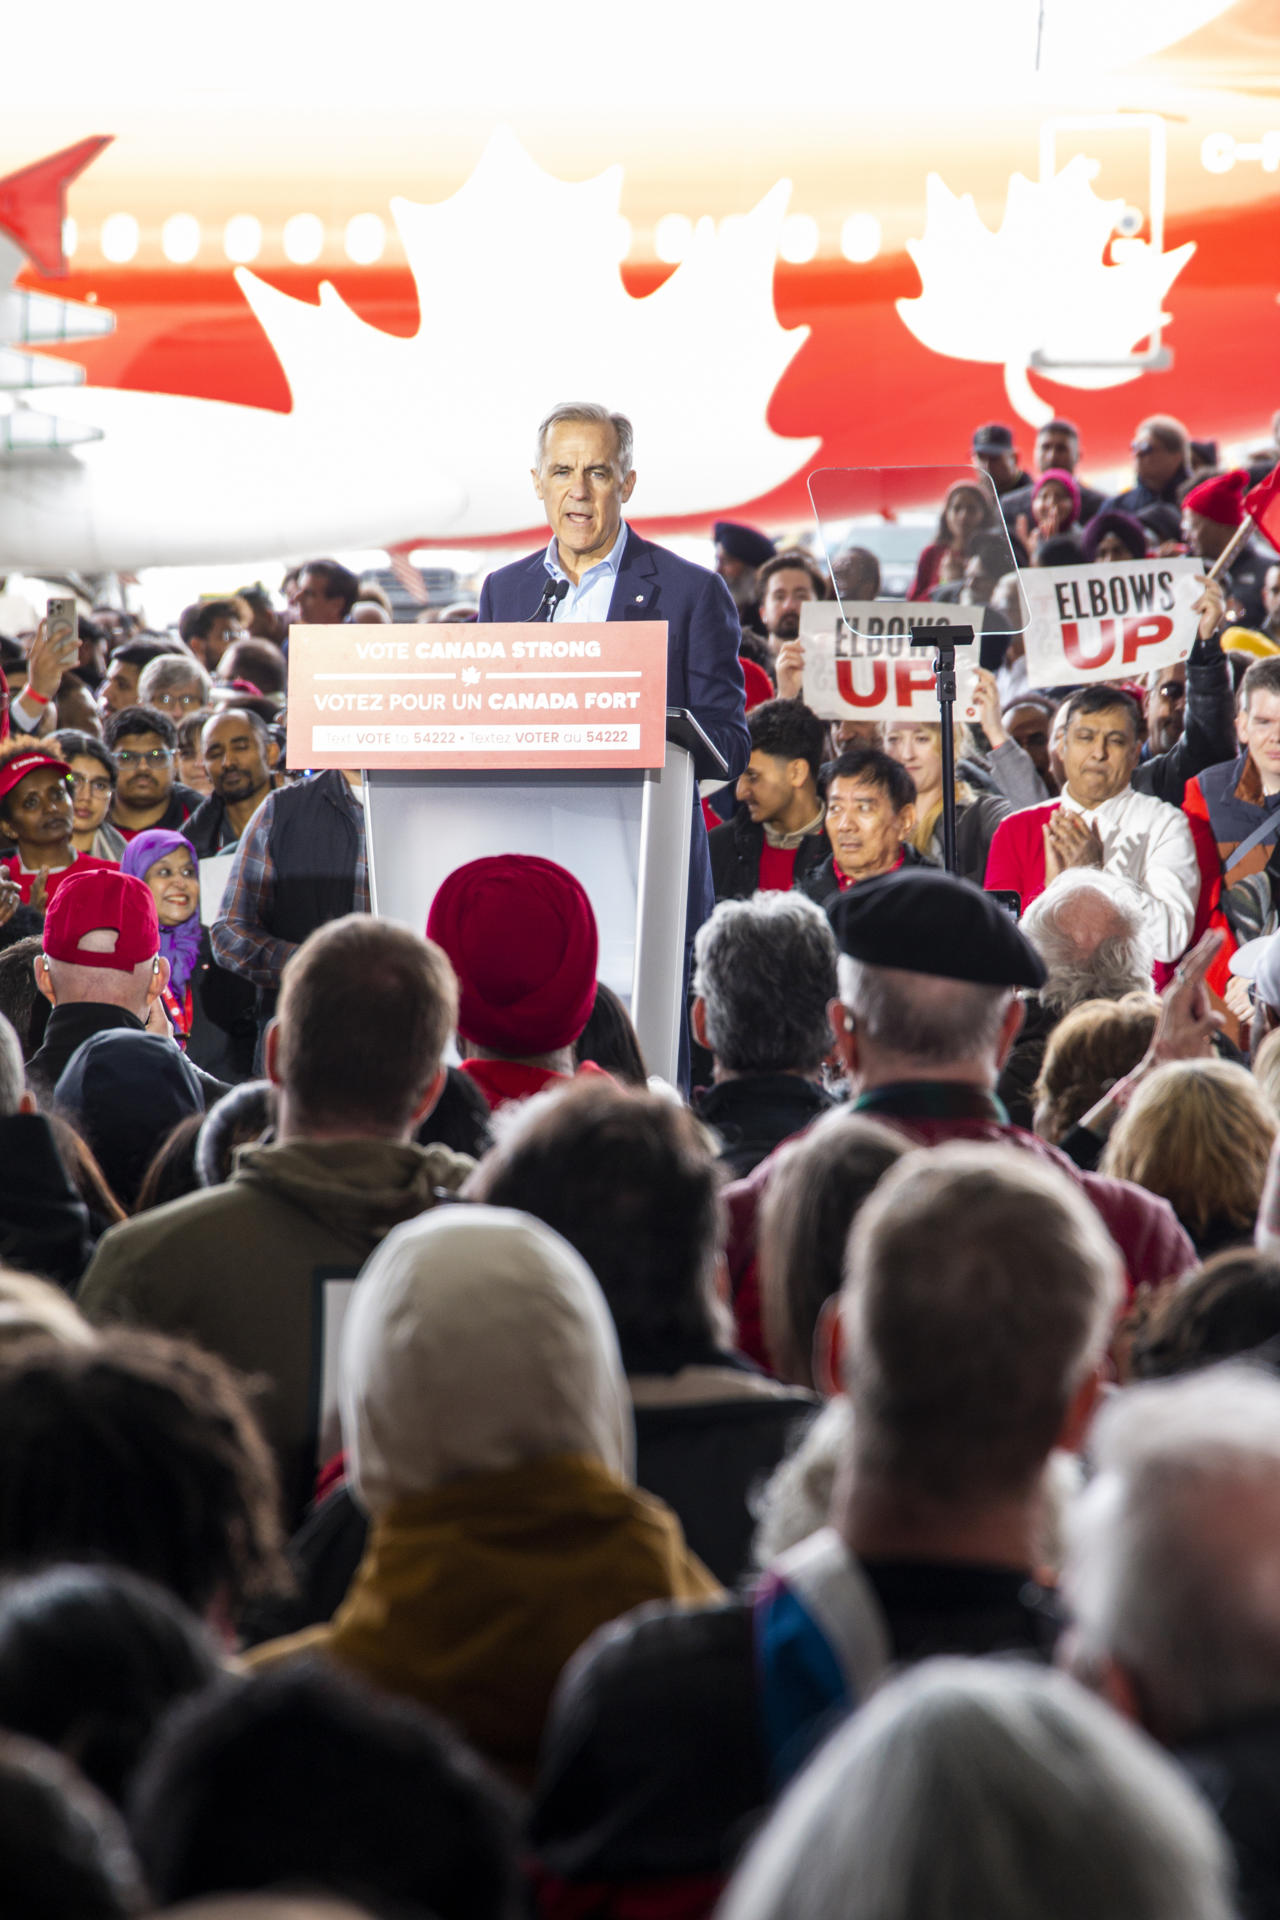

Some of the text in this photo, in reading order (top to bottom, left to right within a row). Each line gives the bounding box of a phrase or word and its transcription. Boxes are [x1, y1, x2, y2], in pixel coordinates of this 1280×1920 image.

[1054, 571, 1175, 620] ELBOWS
[355, 640, 601, 659] VOTE CANADA STRONG
[835, 616, 951, 657] ELBOW
[1061, 615, 1174, 671] UP
[313, 691, 641, 711] VOTEZ POUR UN CANADA FORT
[835, 659, 937, 708] UP
[356, 732, 391, 744] VOTE
[414, 731, 456, 744] 54222
[470, 731, 511, 744] Textez
[515, 731, 560, 744] VOTER
[563, 733, 582, 744] au
[586, 730, 628, 743] 54222
